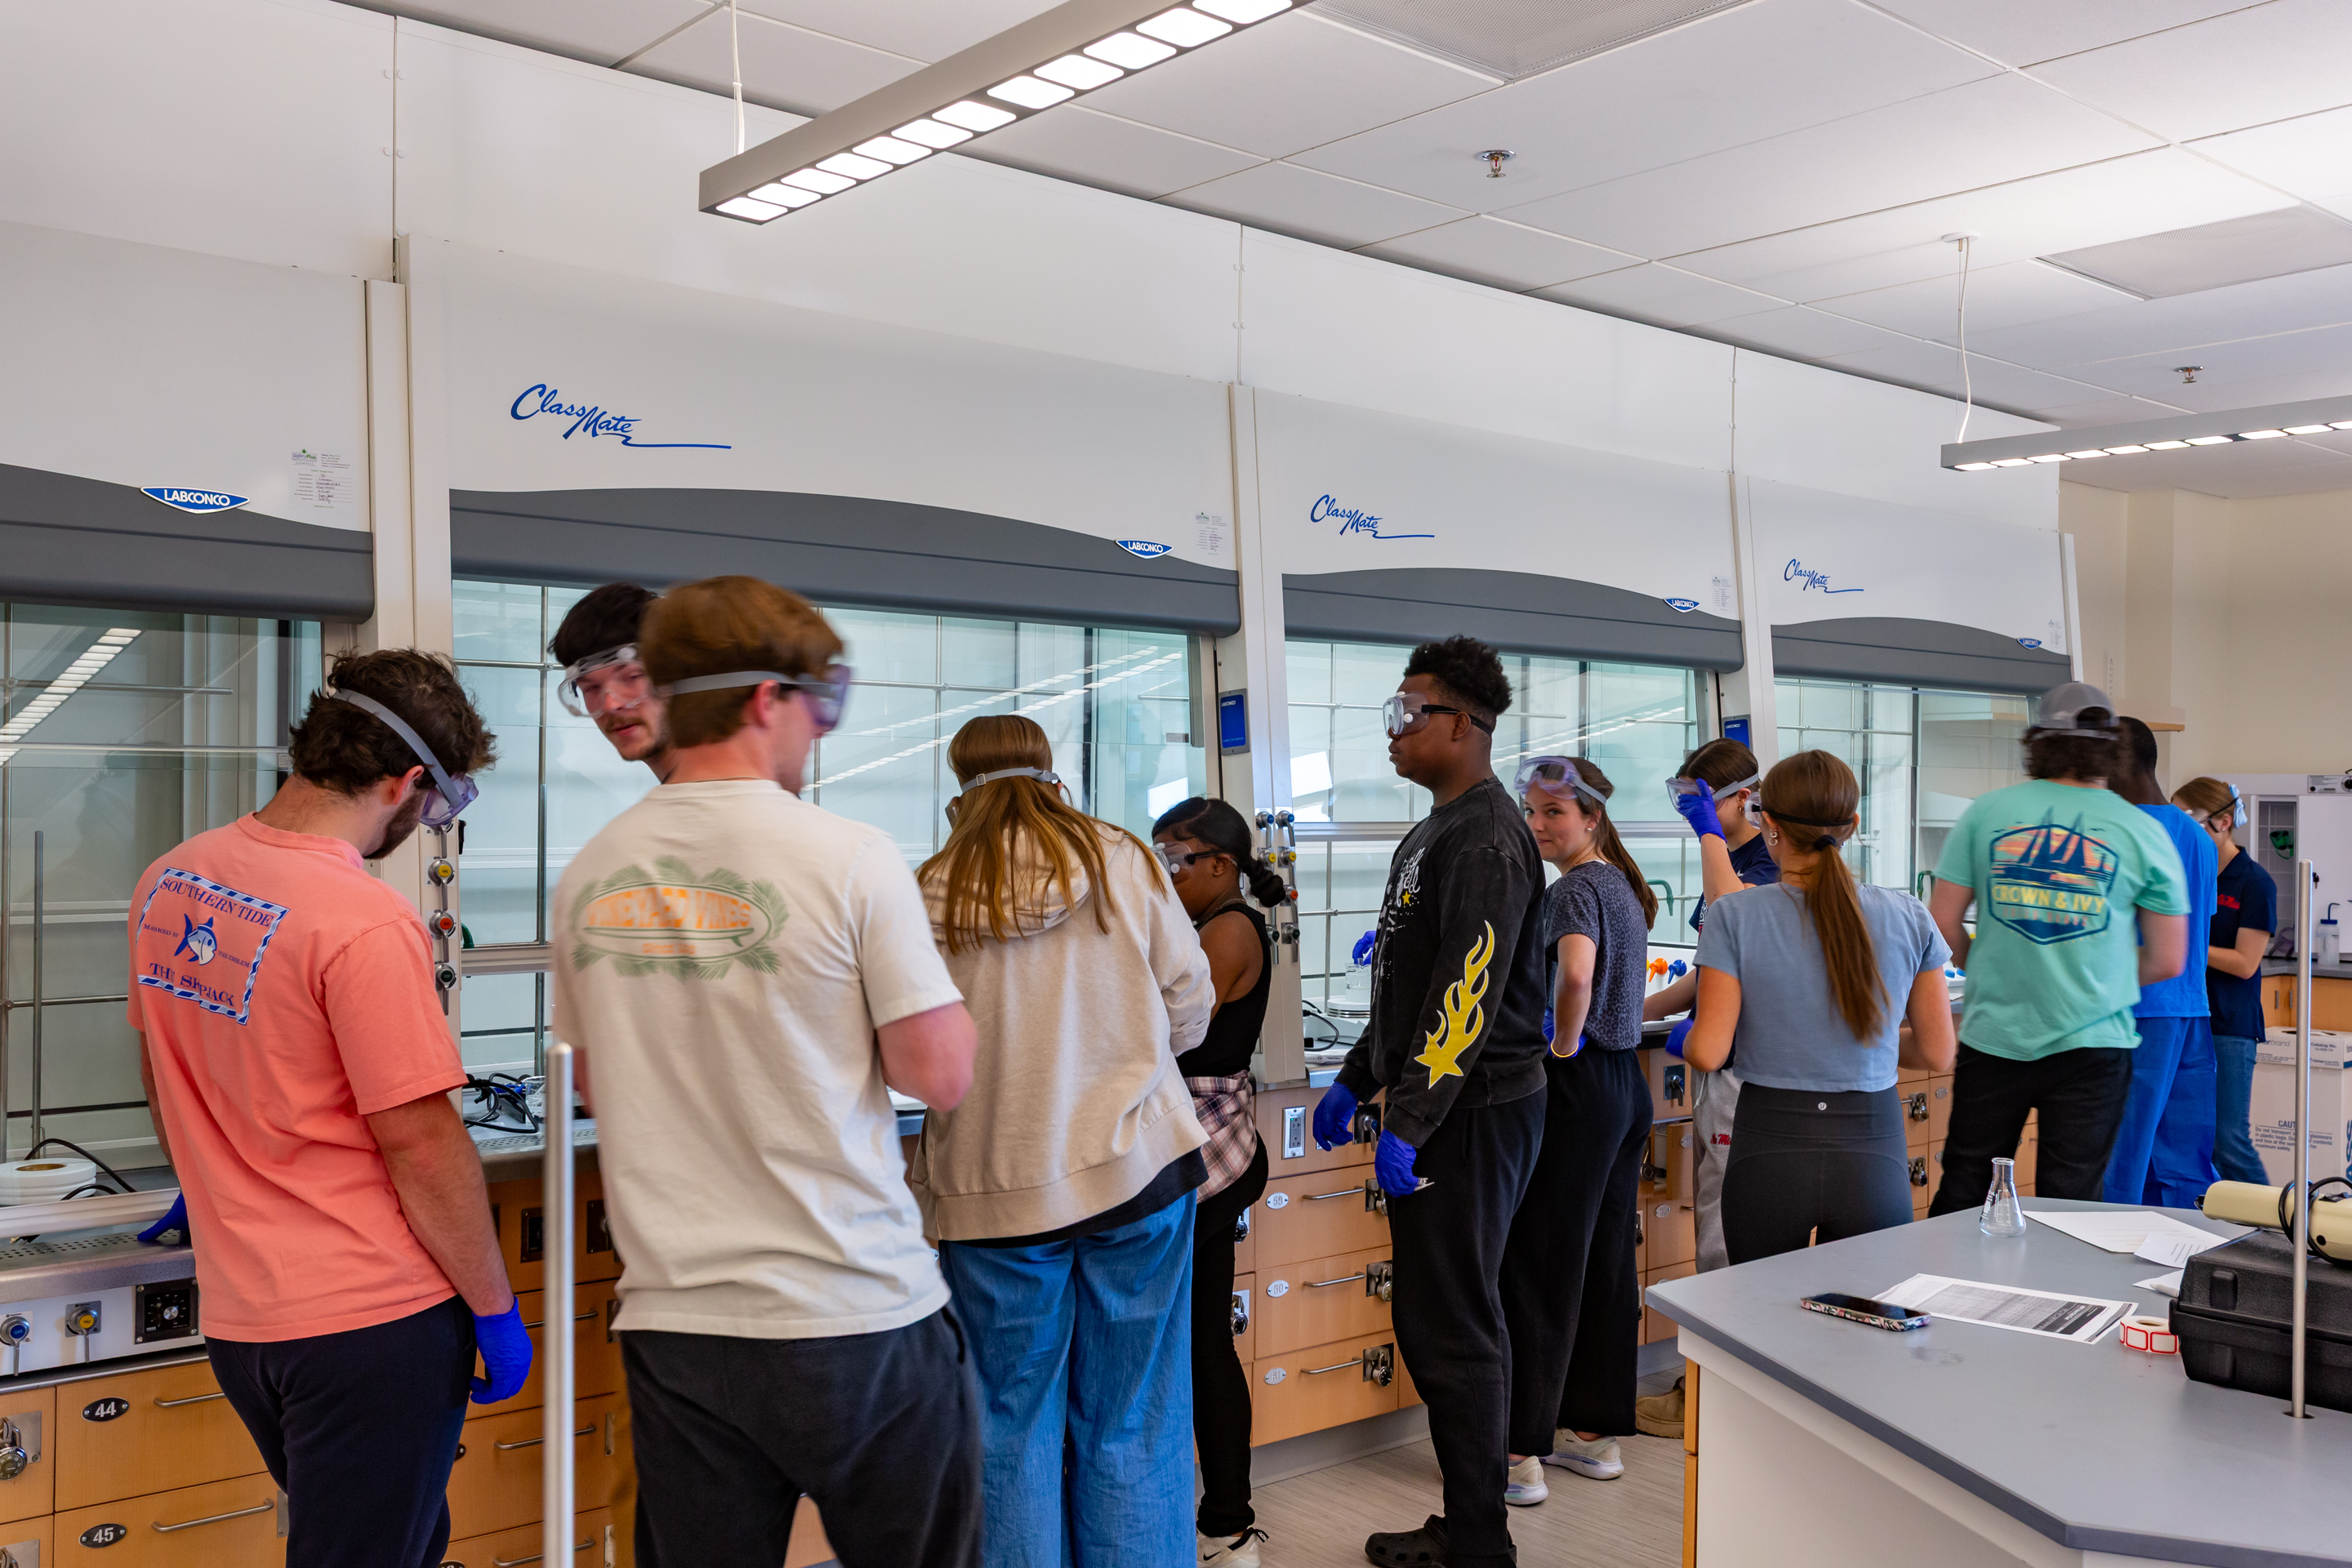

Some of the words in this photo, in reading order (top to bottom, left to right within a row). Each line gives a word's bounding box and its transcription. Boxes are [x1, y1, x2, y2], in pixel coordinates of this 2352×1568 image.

[164, 489, 230, 506] LABCONCO
[1128, 541, 1164, 553] LABCONCO
[1671, 599, 1695, 608] LABCONCO
[160, 878, 237, 914] SOUTHERN
[238, 905, 274, 927] TIDE
[1991, 885, 2050, 906] CROWN
[2055, 893, 2068, 909] &
[2073, 894, 2105, 913] IVY
[143, 924, 171, 936] MARKED
[218, 951, 228, 959] THE
[228, 953, 250, 968] EMBLEM
[149, 963, 175, 981] THE
[2278, 1120, 2296, 1128] CAUT
[95, 1401, 116, 1417] 44
[93, 1527, 114, 1543] 45
